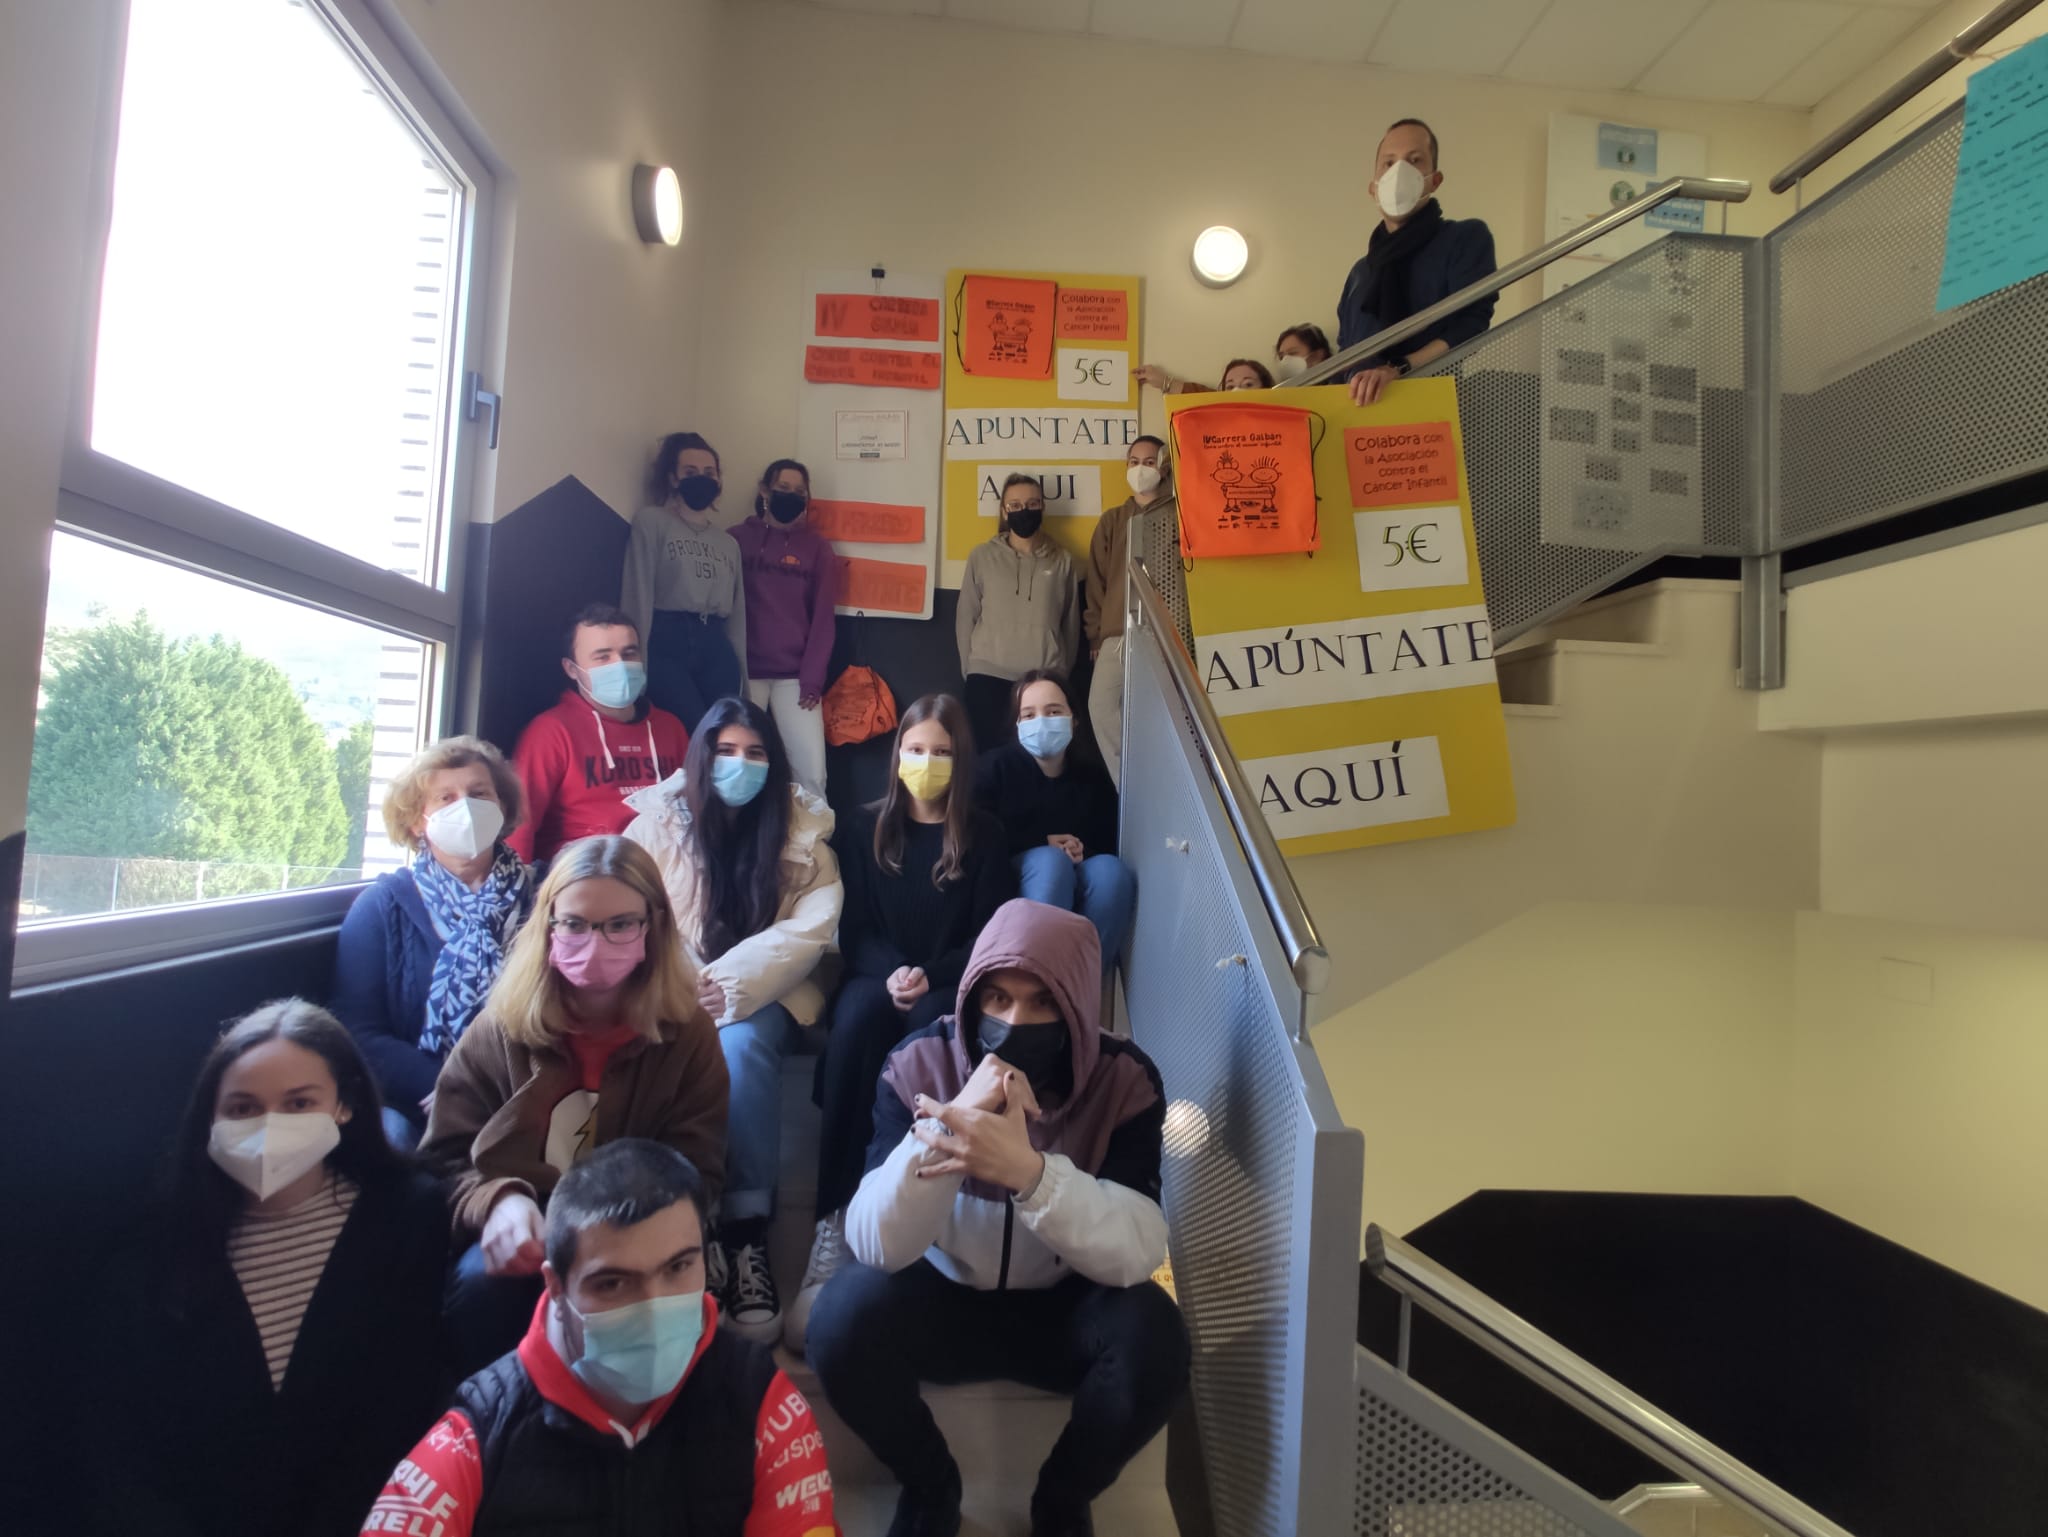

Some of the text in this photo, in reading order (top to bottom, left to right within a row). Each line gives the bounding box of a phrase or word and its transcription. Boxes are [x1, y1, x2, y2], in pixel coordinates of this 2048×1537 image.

[1061, 294, 1105, 304] Colabora
[1072, 357, 1113, 386] 5€
[948, 416, 1137, 446] APUNTATE
[1354, 432, 1444, 451] Colabora con
[1365, 450, 1439, 464] la Asociación
[1378, 464, 1429, 477] contra el
[980, 474, 1077, 500] AUI
[1406, 476, 1447, 490] Infantil
[1382, 523, 1442, 567] 5€
[695, 561, 717, 579] USA
[1206, 620, 1494, 694] APÚNTATE
[1260, 740, 1411, 814] AQUÍ
